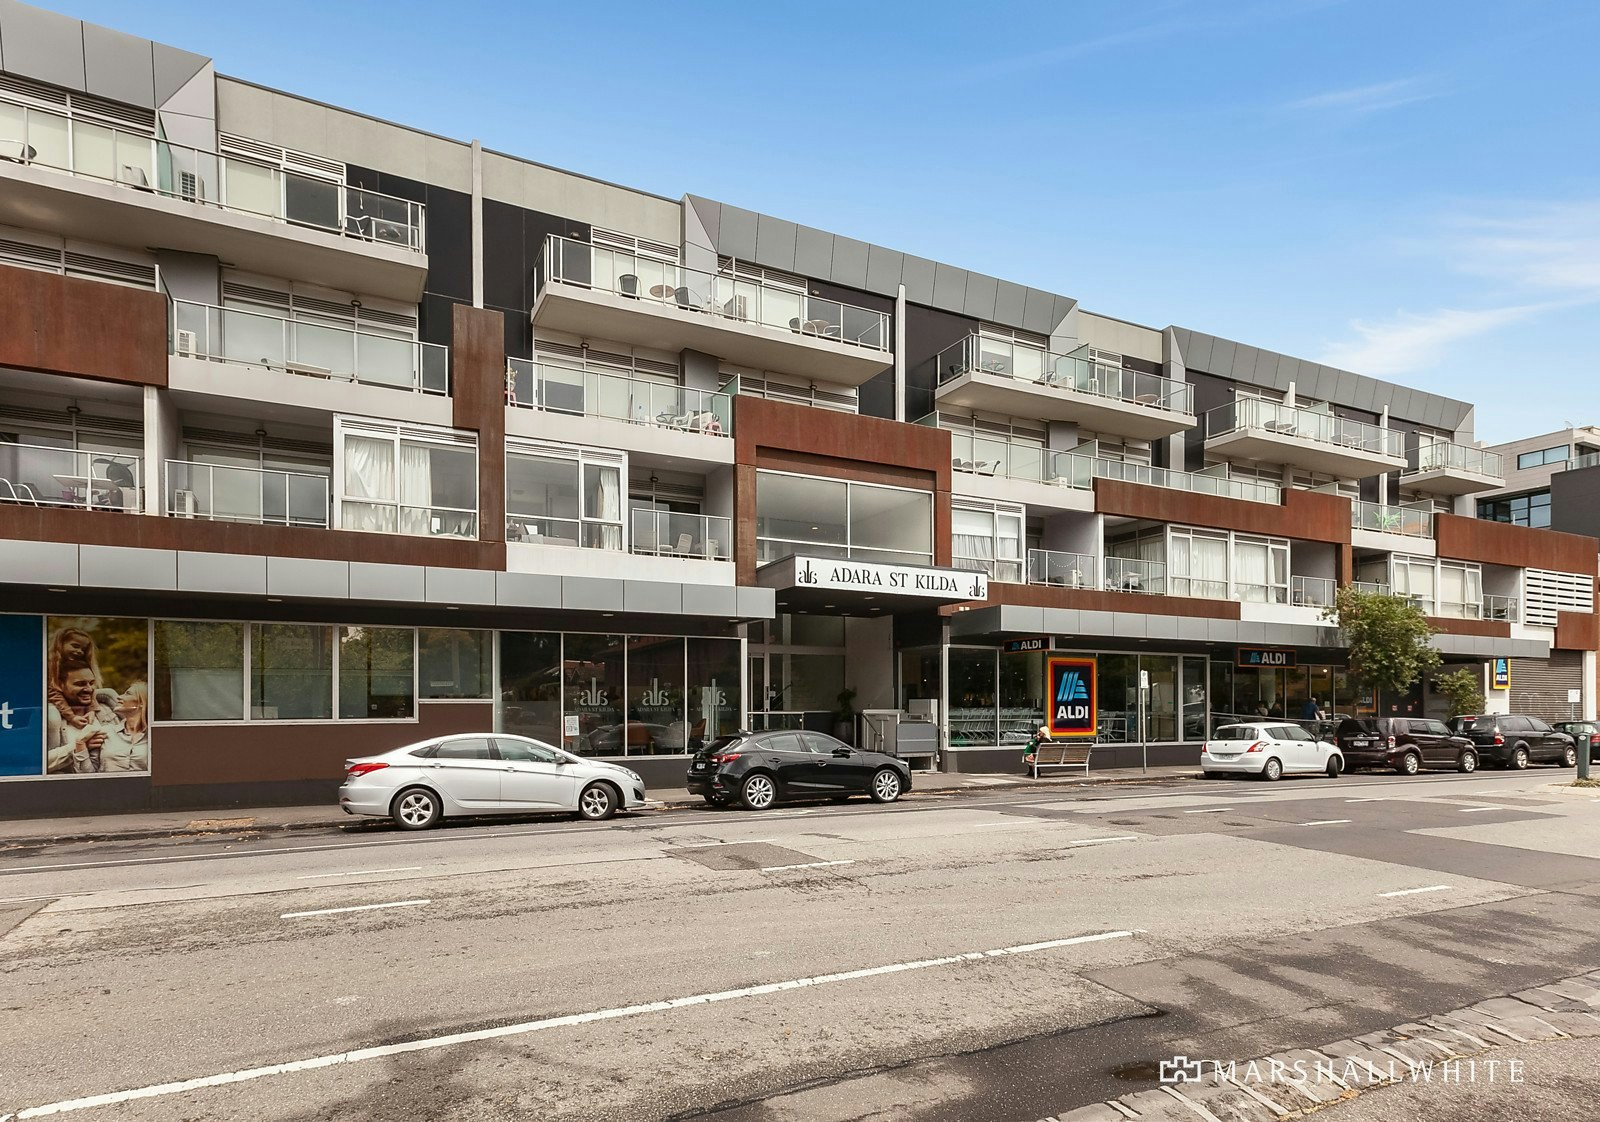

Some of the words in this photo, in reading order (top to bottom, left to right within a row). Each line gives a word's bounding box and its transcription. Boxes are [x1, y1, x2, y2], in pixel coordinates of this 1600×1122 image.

[830, 567, 883, 586] ADARA
[889, 572, 909, 588] ST
[915, 574, 958, 592] KILDA
[1021, 640, 1042, 650] ALDI
[1261, 652, 1286, 664] ALDI
[1057, 705, 1089, 719] ALDI
